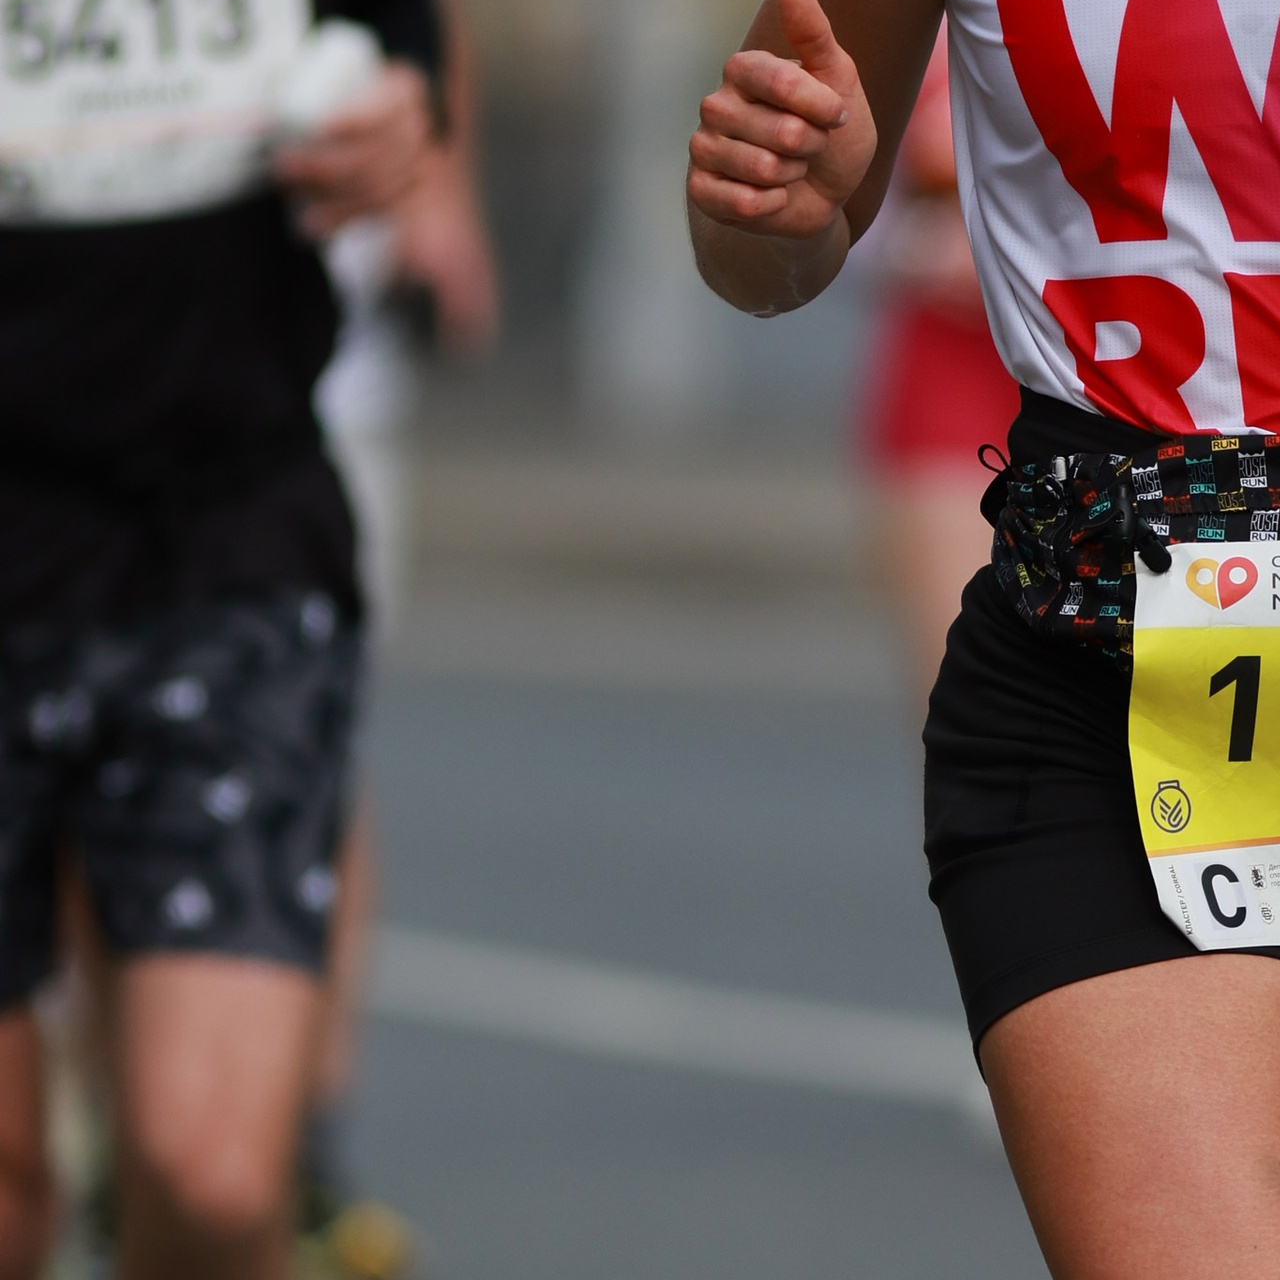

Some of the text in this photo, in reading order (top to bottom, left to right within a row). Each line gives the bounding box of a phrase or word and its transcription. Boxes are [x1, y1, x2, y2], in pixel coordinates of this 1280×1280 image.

[1213, 440, 1237, 450] RUN
[1159, 447, 1183, 458] RUN
[1238, 457, 1267, 478] ROSA
[1131, 470, 1161, 494] ROSA
[1241, 477, 1266, 487] RUN
[1190, 484, 1216, 494] RUN
[1250, 512, 1280, 531] ROSA
[1198, 529, 1224, 539] RUN
[1251, 531, 1277, 541] RUN
[1101, 607, 1119, 615] RUN
[1168, 865, 1182, 893] CORRAL
[1201, 863, 1247, 929] C
[1179, 900, 1194, 935] КЛАСТЕР
